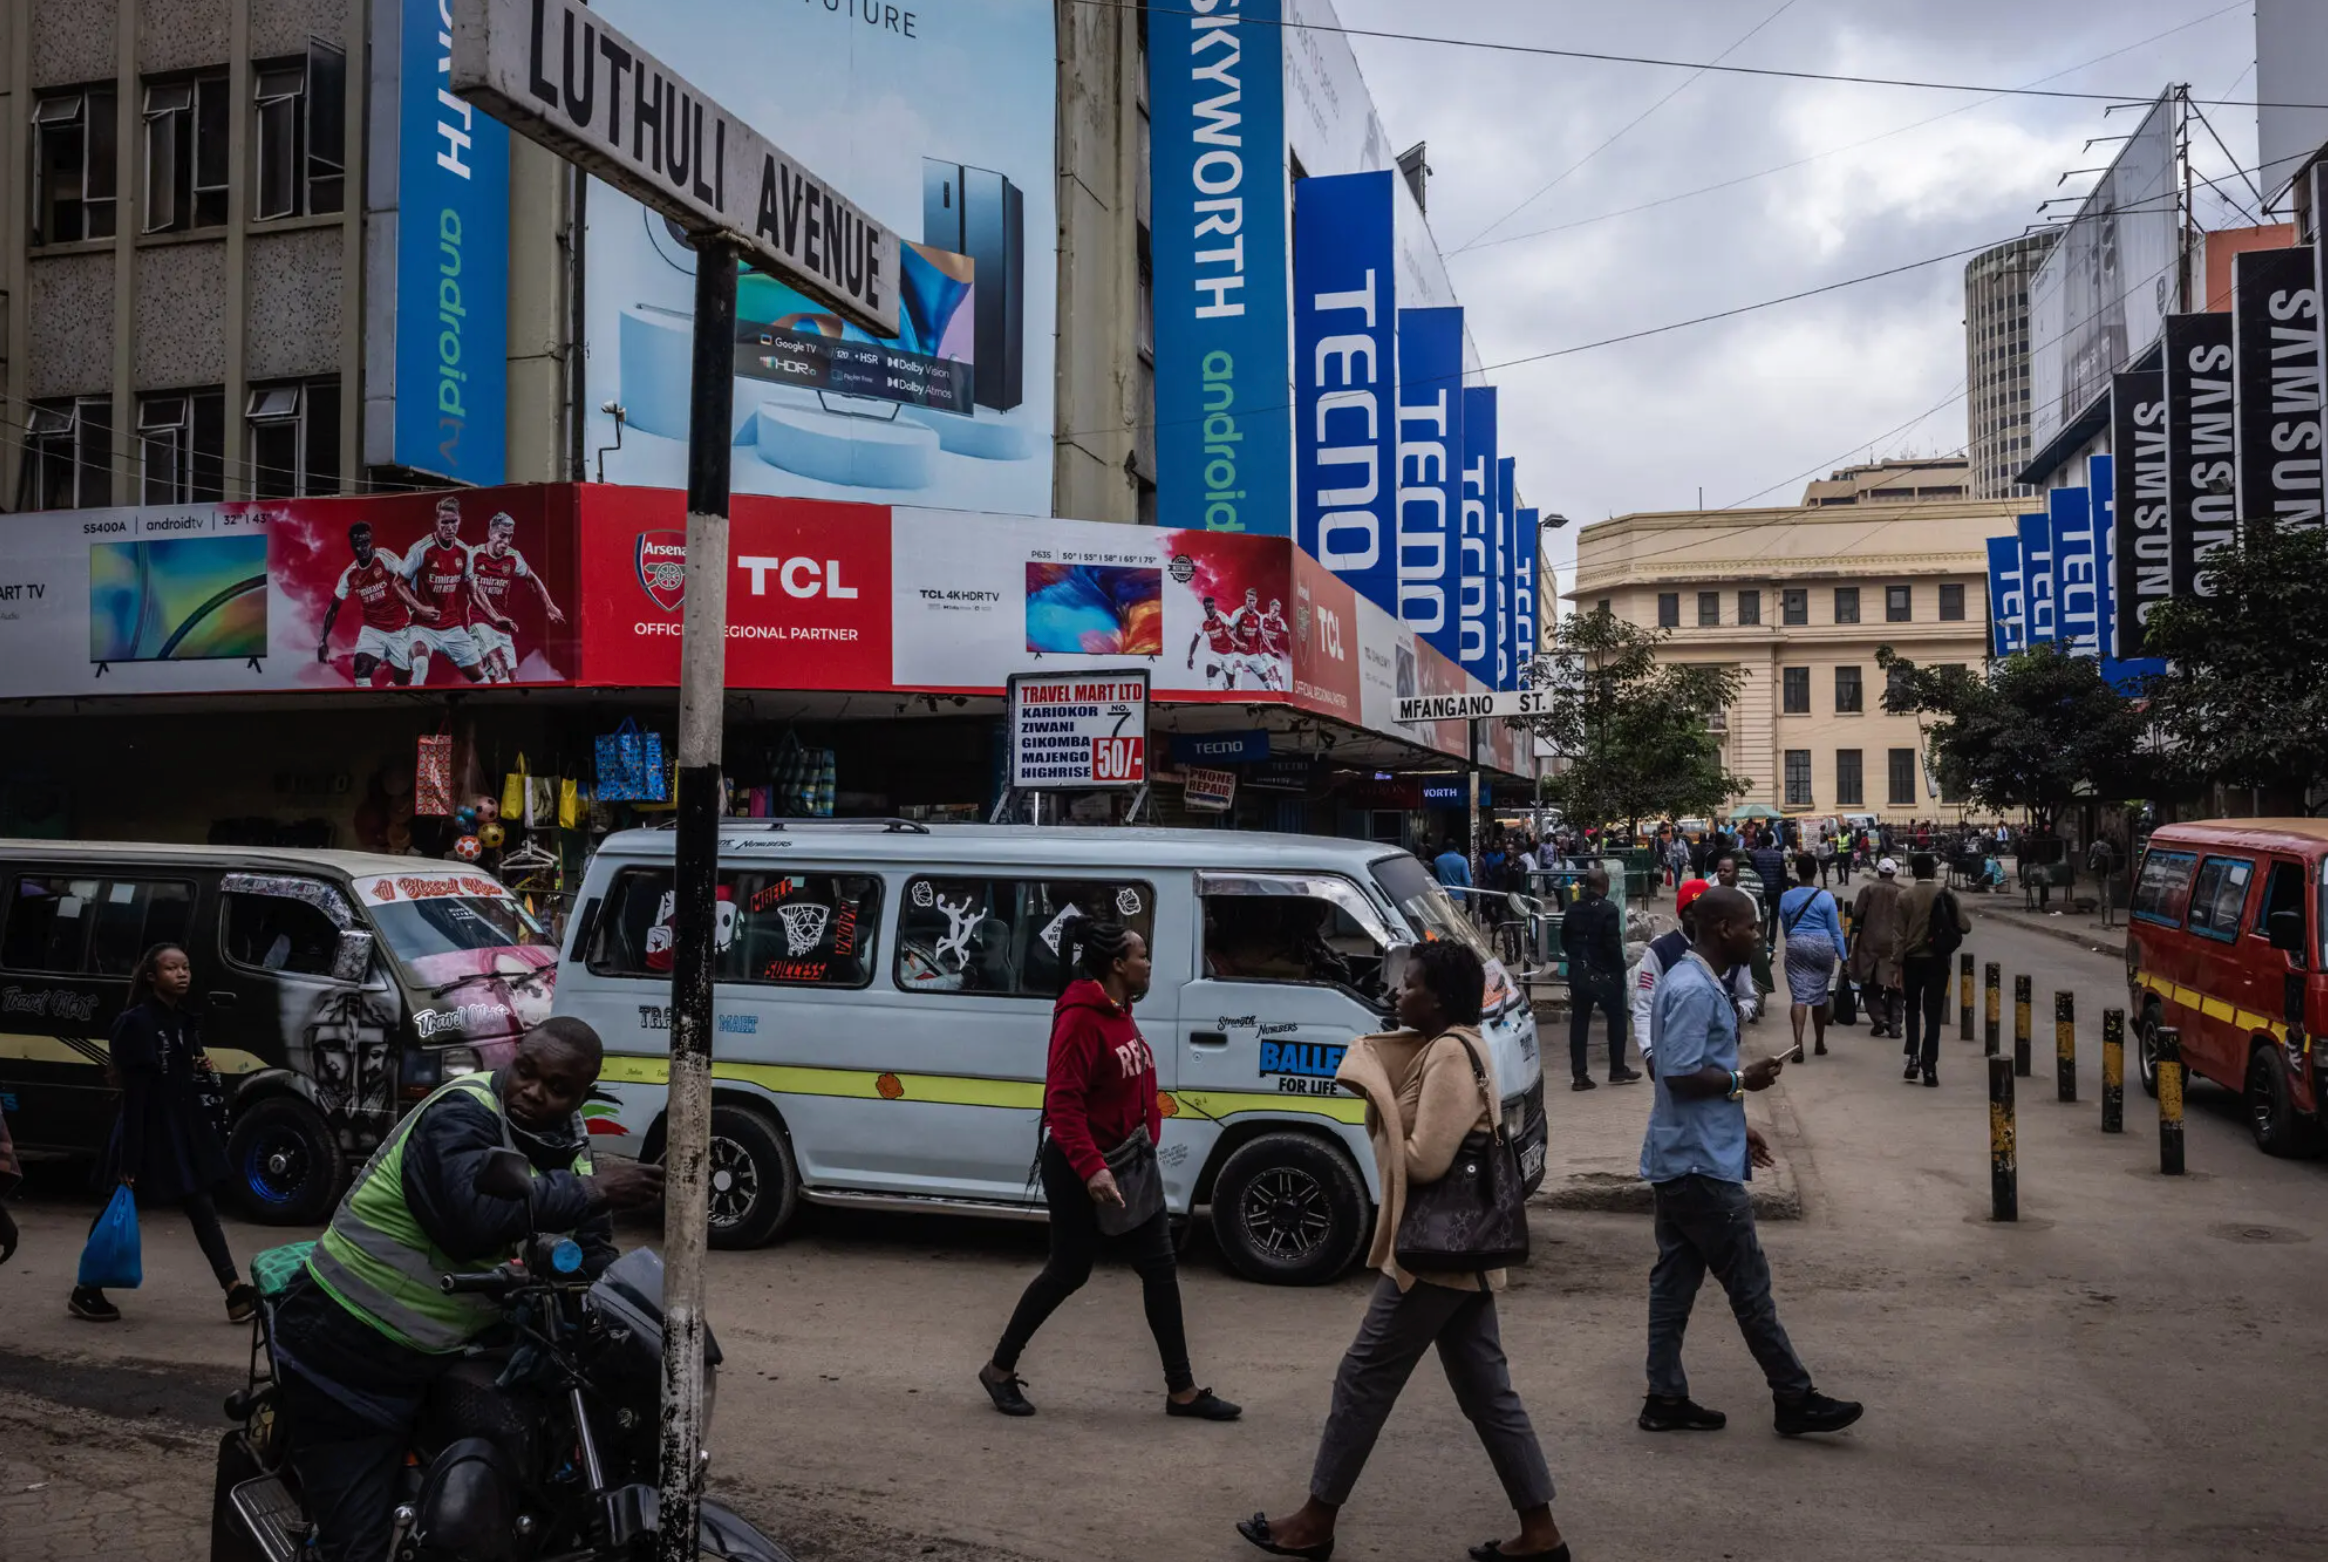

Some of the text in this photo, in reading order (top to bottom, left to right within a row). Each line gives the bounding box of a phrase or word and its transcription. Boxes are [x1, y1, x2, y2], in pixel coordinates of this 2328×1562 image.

[805, 0, 917, 39] URE
[530, 0, 880, 311] LUTHULI AVENUE
[775, 336, 817, 353] Google TV
[860, 352, 878, 365] HSR
[899, 358, 949, 378] Dolby Vision
[899, 377, 953, 399] Dolby Atmos
[1313, 268, 1379, 571] TECNO
[2268, 288, 2322, 536] SAMSUN
[1400, 388, 1447, 634] TECNO
[83, 520, 127, 535] S5400A
[643, 541, 688, 556] Arsena
[1031, 551, 1052, 560] P635
[737, 555, 859, 599] TCL
[26, 584, 46, 599] TV
[919, 589, 945, 600] TCL
[634, 621, 859, 642] OFFICI EGIONAL PARTNER
[1317, 605, 1345, 661] TCL
[1021, 683, 1143, 703] TRAVEL MART LTD
[1022, 706, 1098, 718] KARIOKOR
[1110, 704, 1130, 712] NO.
[1400, 692, 1547, 719] MFANGANO ST.
[1021, 721, 1075, 733] ZIWANI
[1107, 712, 1132, 738] 7
[1021, 736, 1091, 748] GIKOMBA
[1193, 740, 1244, 755] TECNO
[1021, 751, 1090, 763] MAJENGO
[1097, 739, 1143, 778] 50/-
[1021, 766, 1091, 778] HIGHRISE
[1189, 768, 1235, 785] PHONE
[1187, 780, 1231, 796] REPAIR
[763, 960, 828, 981] SUCCESS
[413, 1008, 466, 1038] Travel
[638, 1004, 759, 1034] TRA MART
[1217, 1015, 1257, 1031] Strength
[1260, 1041, 1348, 1077] BALLE
[1278, 1077, 1338, 1096] FOR LIFE
